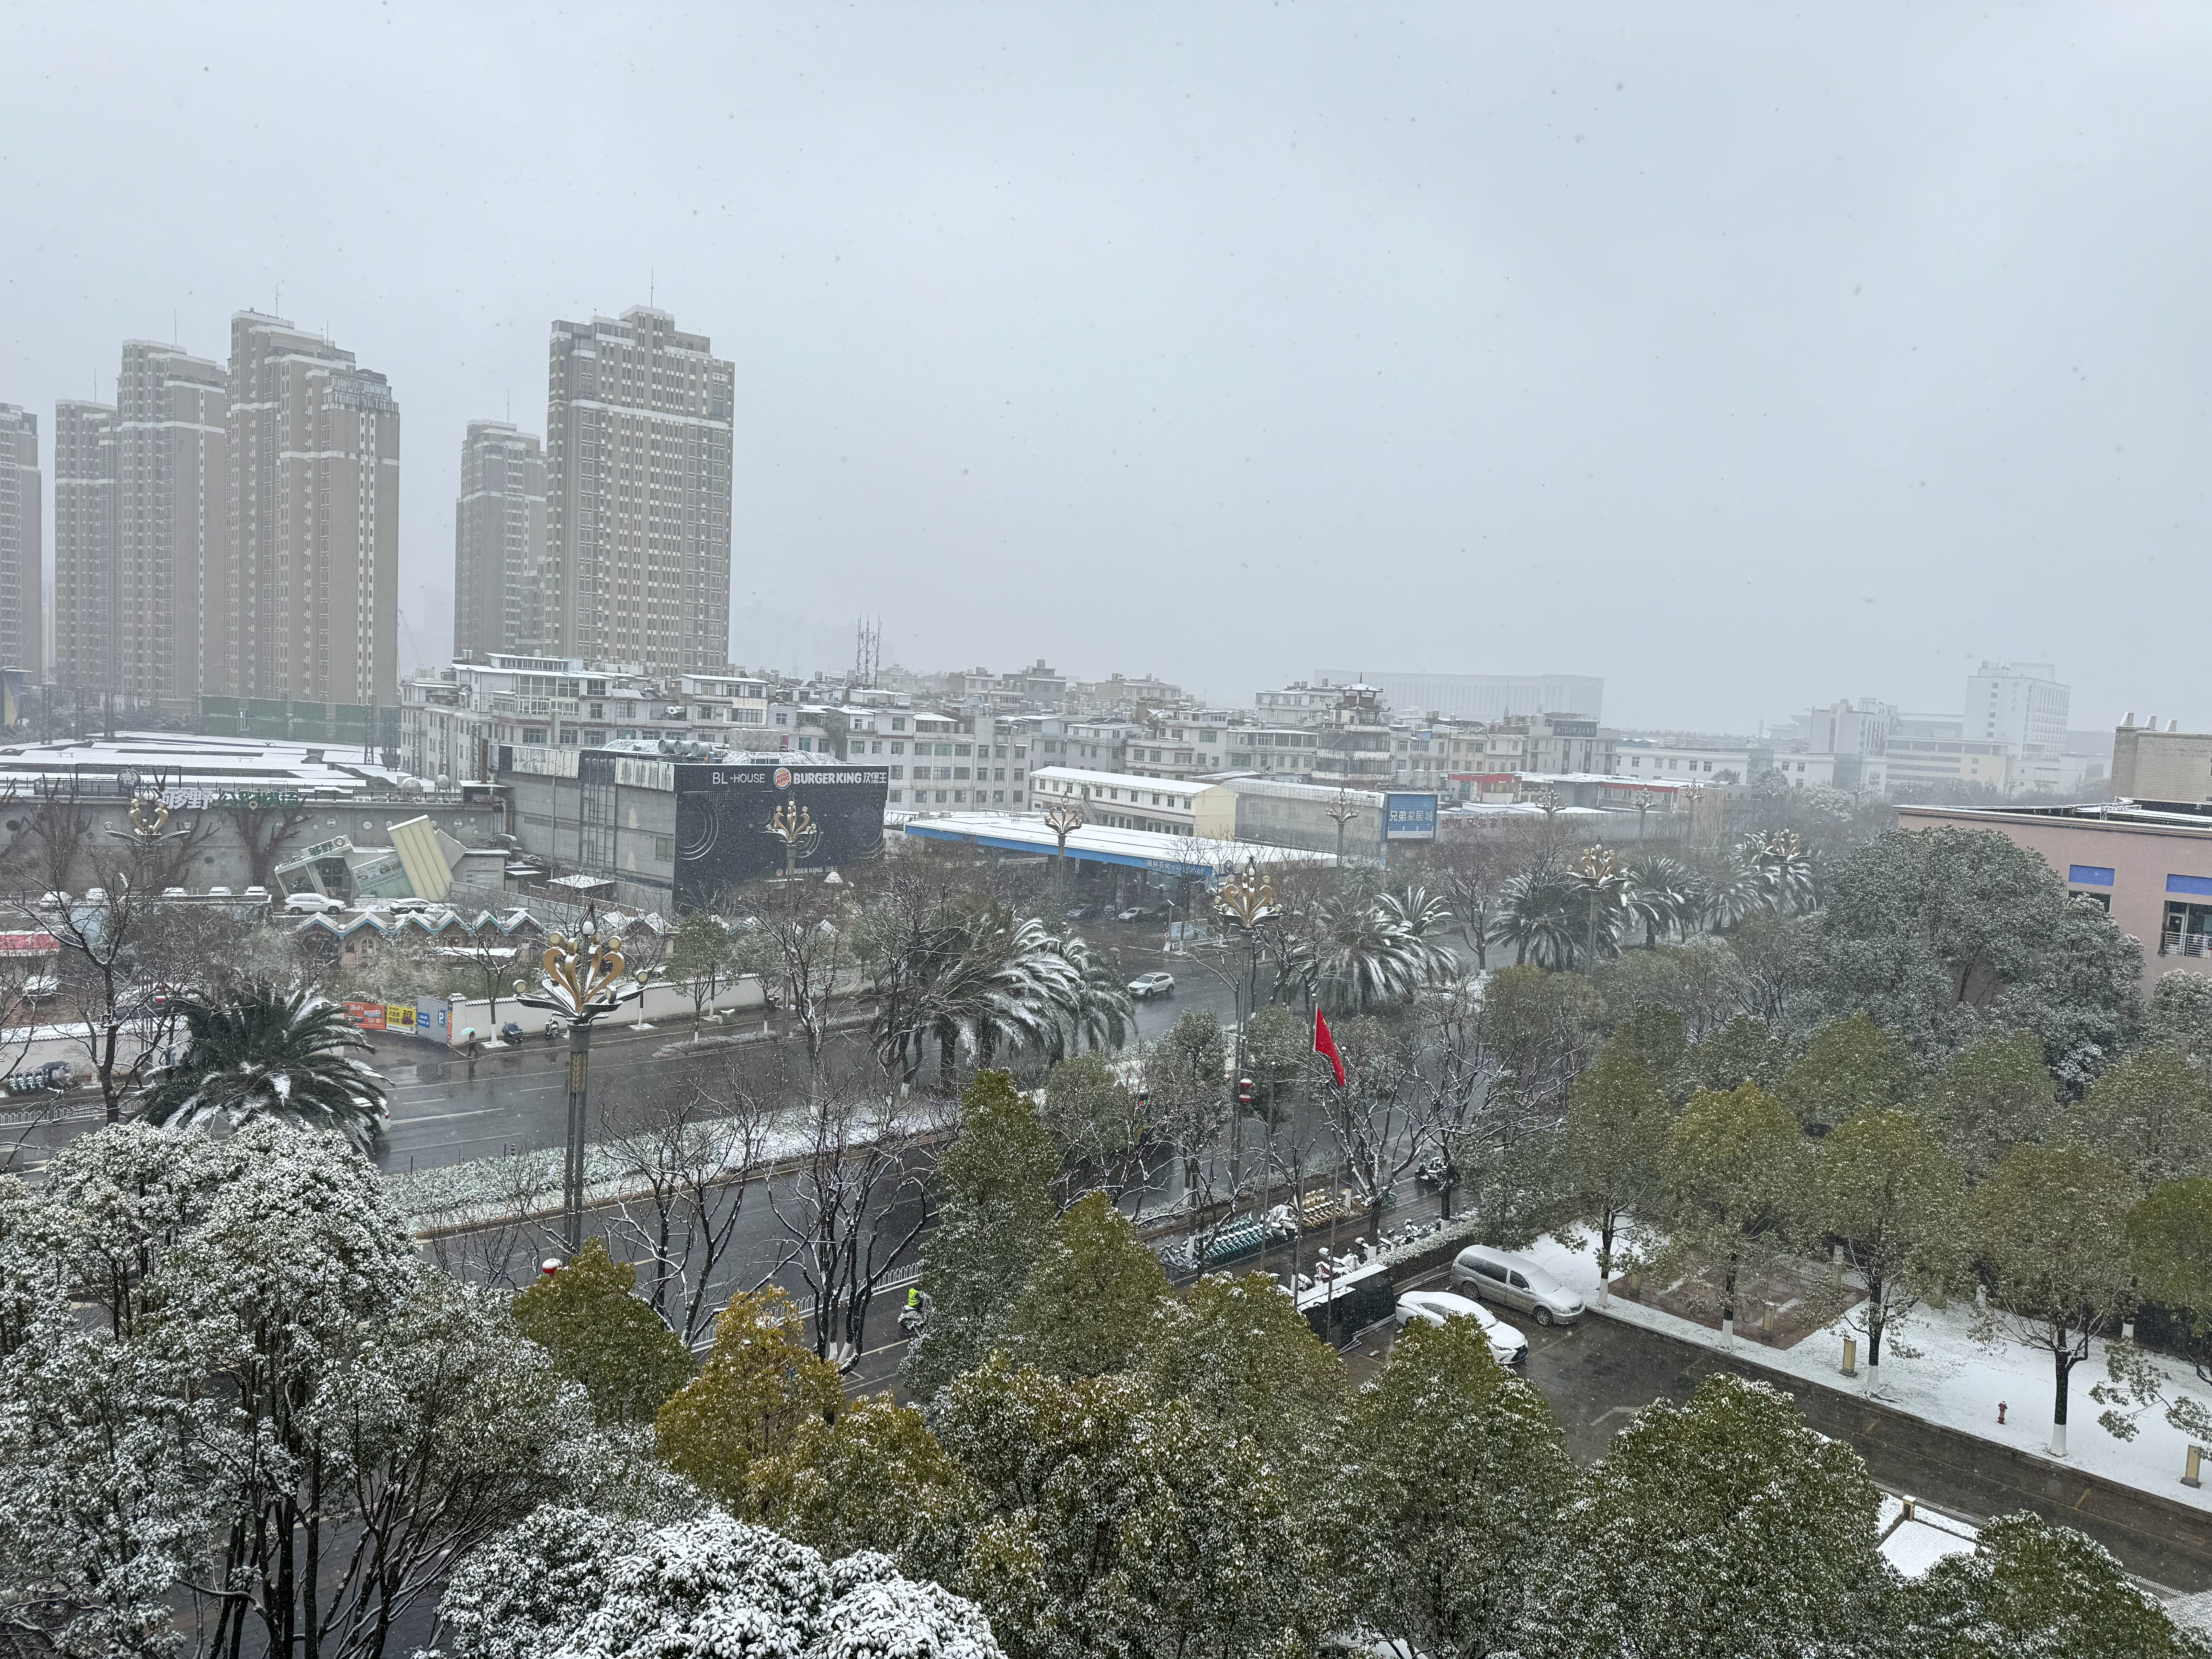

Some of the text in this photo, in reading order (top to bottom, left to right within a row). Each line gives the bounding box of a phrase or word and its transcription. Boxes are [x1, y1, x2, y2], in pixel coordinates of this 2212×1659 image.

[712, 772, 728, 785] BL
[863, 772, 887, 784] 汉堡王
[160, 788, 214, 810] 够野
[1389, 810, 1433, 823] 兄弟家居城
[308, 841, 334, 856] 够野
[439, 1012, 444, 1024] P
